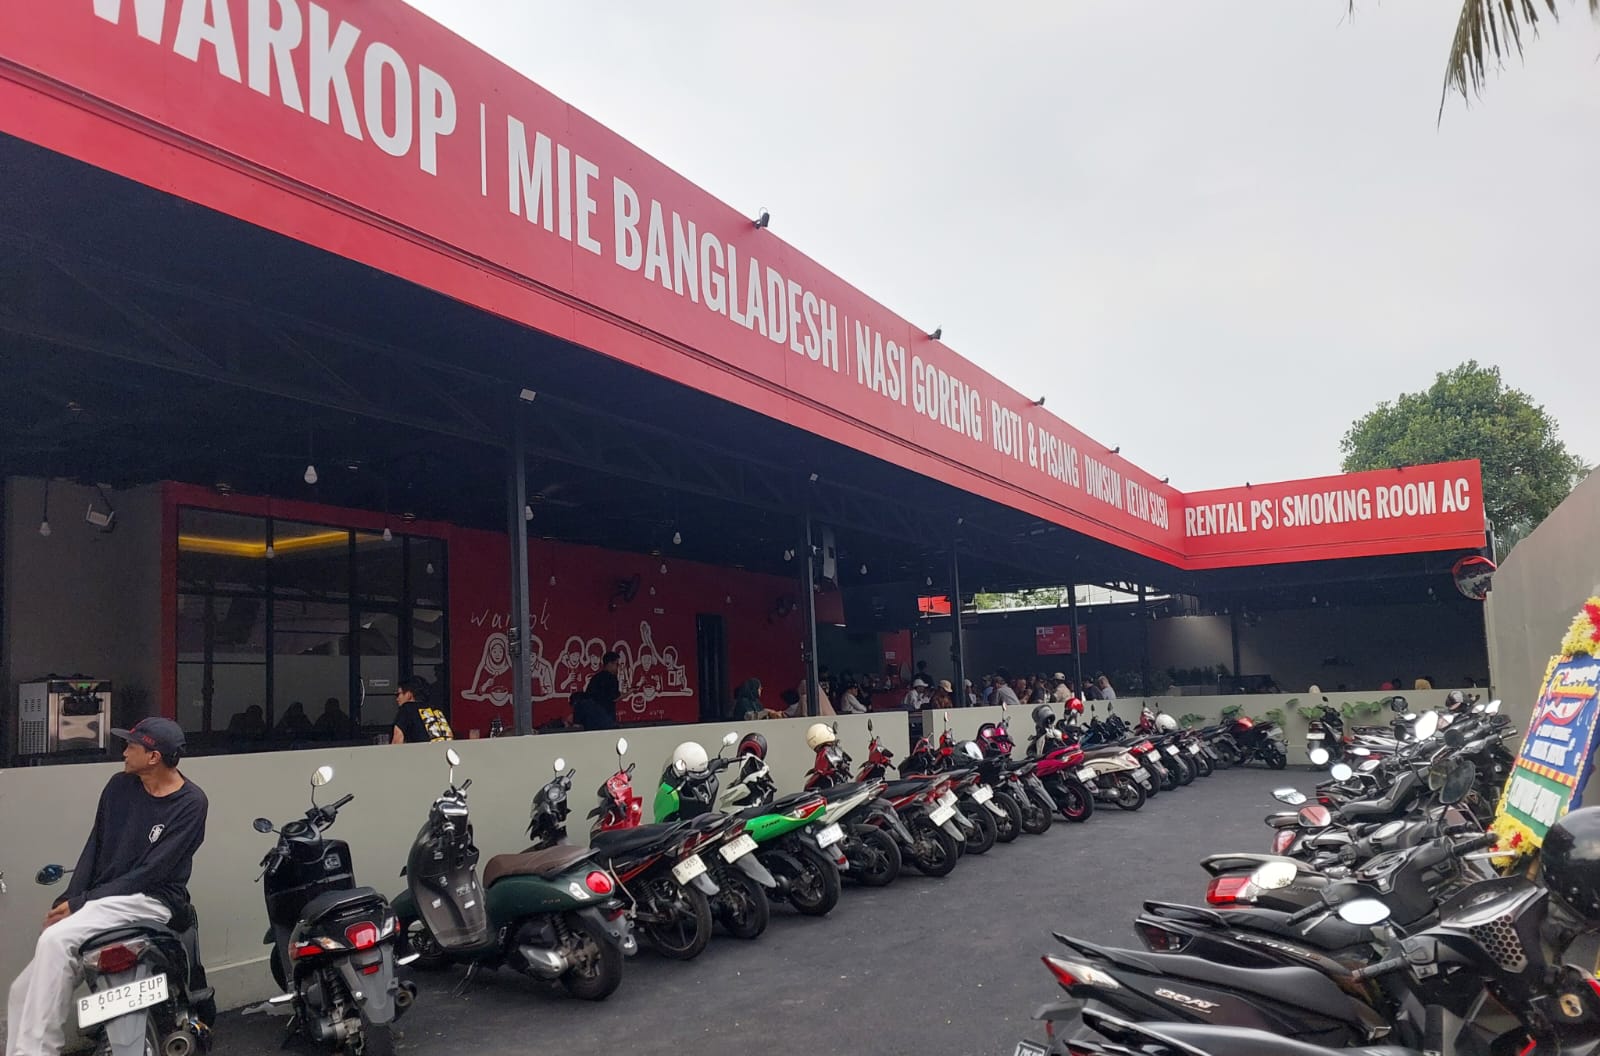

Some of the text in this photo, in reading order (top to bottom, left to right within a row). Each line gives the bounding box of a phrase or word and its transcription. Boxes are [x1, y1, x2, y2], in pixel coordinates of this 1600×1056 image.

[507, 115, 601, 256] MIE
[613, 176, 839, 373] BANGLADESH
[855, 319, 907, 406] NASI
[911, 355, 983, 442] GORENG
[991, 400, 1024, 463] ROTI
[1027, 422, 1038, 468] &
[1038, 427, 1080, 489] PISANG
[1084, 454, 1123, 510] DIMSUM
[1125, 478, 1149, 522] KETAN
[1148, 491, 1169, 531] SUSU
[1184, 478, 1471, 537] RENTAL PS SMOKING ROOM AC
[81, 977, 163, 1011] B 6012 EUP
